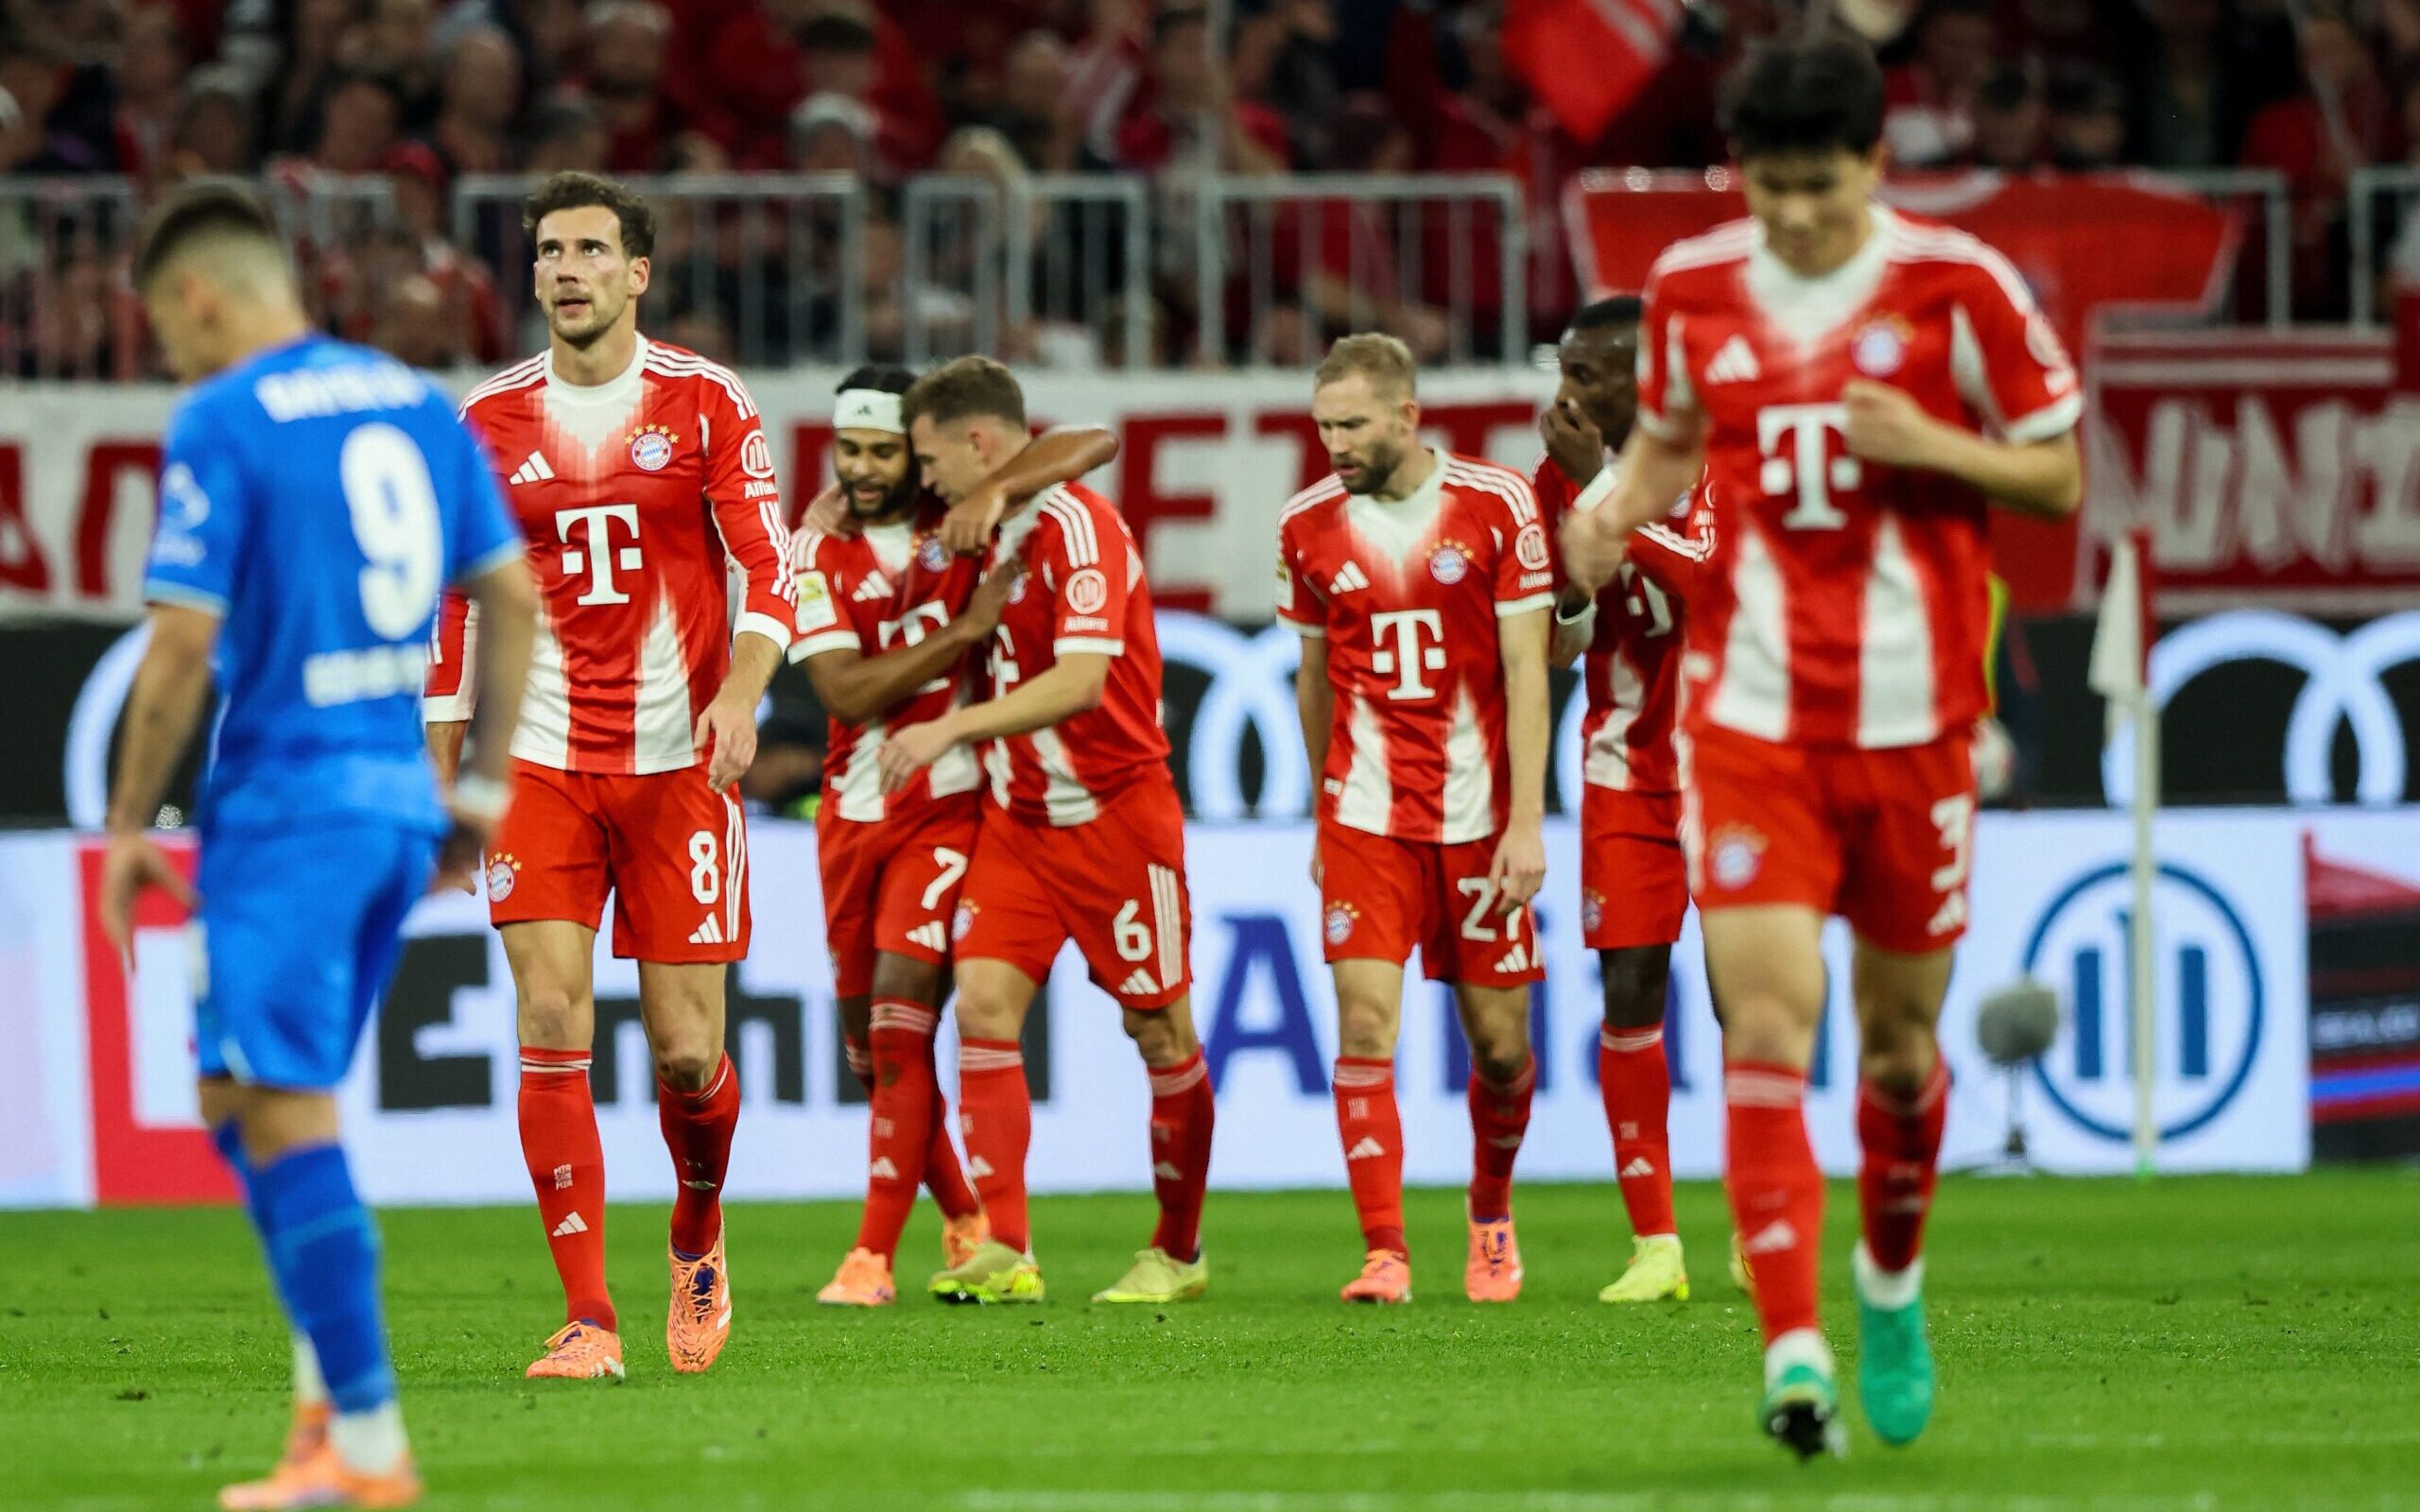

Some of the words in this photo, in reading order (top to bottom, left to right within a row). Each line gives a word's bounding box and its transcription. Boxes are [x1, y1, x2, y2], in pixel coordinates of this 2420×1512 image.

[340, 421, 442, 640] 9
[555, 503, 643, 606] T
[1370, 609, 1447, 700] T
[688, 830, 719, 904] 8
[921, 846, 968, 910] 7
[1929, 792, 1970, 892] 3
[1113, 899, 1152, 962] 6
